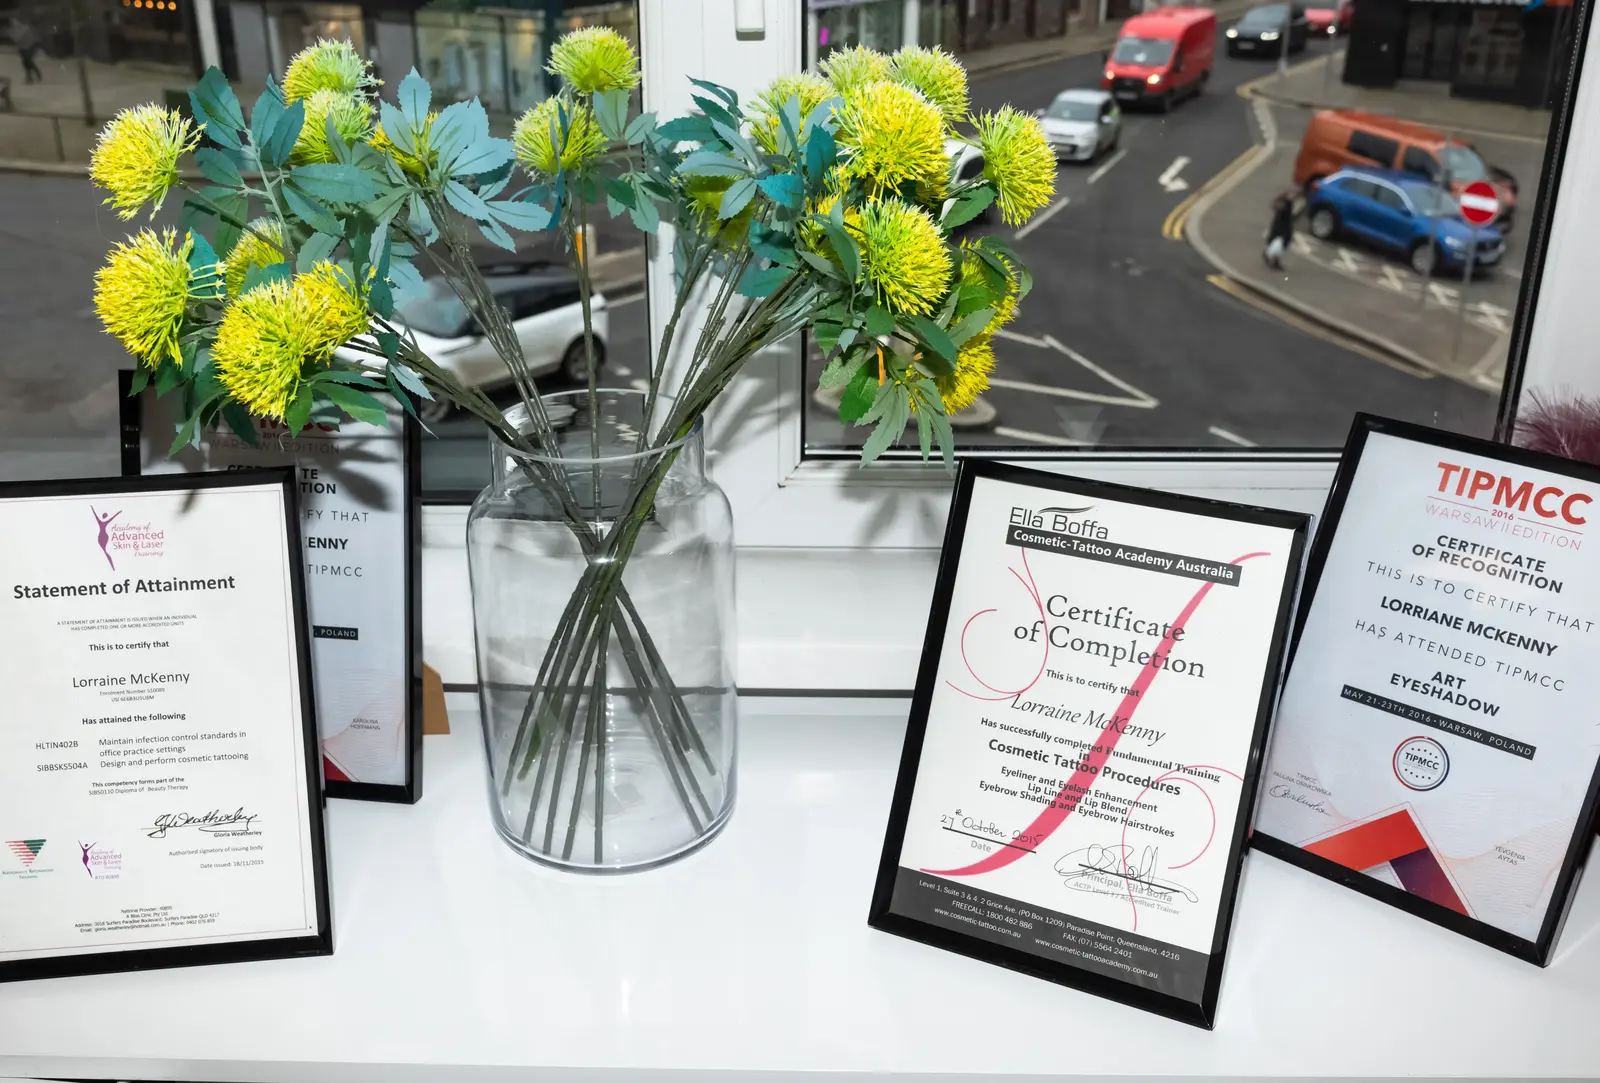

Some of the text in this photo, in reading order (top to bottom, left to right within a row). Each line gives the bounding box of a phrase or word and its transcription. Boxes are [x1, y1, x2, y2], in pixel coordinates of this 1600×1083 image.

[1437, 461, 1594, 526] TIPMCC
[331, 510, 369, 523] THAT
[1008, 506, 1109, 541] Ella Boffa
[1424, 502, 1582, 551] WARSAW EDITION
[1491, 508, 1514, 521] 2016
[111, 529, 164, 542] Advanced
[112, 540, 164, 550] Skin Laser
[305, 536, 349, 550] ENNY
[1013, 529, 1234, 580] Cosmetic-Tattoo Academy Australia
[1436, 534, 1547, 573] CERTIFICATE
[307, 564, 363, 578] TIPMCC
[1411, 543, 1564, 594] OF RECOGNITION
[13, 575, 236, 600] Statement of Attainment
[1367, 560, 1595, 633] THIS IS TO CERTIFY THAT
[1046, 594, 1186, 642] Certificate
[1380, 595, 1559, 657] LORRIANE MCKENNY
[88, 643, 106, 652] This
[106, 643, 114, 651] is
[125, 640, 152, 650] certify
[152, 640, 170, 648] that
[321, 628, 356, 638] POLAND
[1014, 620, 1205, 679] of Completion
[1354, 619, 1565, 692] HAS ATTENDED TIPMCC
[72, 672, 190, 688] Lorraine McKenny
[1046, 668, 1140, 697] This is to certify that
[1430, 671, 1467, 690] ART
[1389, 672, 1501, 717] EYESHADOW
[81, 712, 186, 725] Has attained the following
[1010, 691, 1167, 747] Lorraine McKenny
[1343, 688, 1532, 756] MAY 21-23TH 2016 WARSAW, POLAND
[35, 740, 79, 750] HLTIN402B
[98, 738, 134, 746] Maintain
[135, 735, 170, 744] infection
[171, 733, 199, 742] control
[200, 731, 238, 740] standards
[99, 746, 186, 757] office practice settings
[980, 717, 1221, 783] Has successfully completed Fundamental Training
[100, 753, 249, 769] Design and perform cosmetic tattooing
[988, 739, 1181, 796] Cosmetic Tattoo Procedures
[1078, 748, 1091, 762] in
[1405, 751, 1440, 771] TIPMCC
[104, 780, 138, 788] competency
[1000, 765, 1158, 813] Eyeliner and Eyelash Enhancement
[979, 780, 1175, 838] Eyebrow Shading and Eyebrow Hairstrokes
[1027, 782, 1128, 816] Lip Line and Lip Blend
[231, 829, 262, 837] Weatherley
[962, 816, 1007, 838] October
[1012, 829, 1044, 847] 2015
[970, 839, 992, 853] Date
[1127, 882, 1144, 895] Ella
[1147, 887, 1173, 903] Boffa
[919, 879, 936, 890] Level
[943, 886, 960, 897] Suite
[986, 899, 1003, 910] Grice
[1018, 909, 1031, 918] (PO
[1030, 912, 1044, 922] Box
[1045, 916, 1066, 929] 1209)
[1066, 922, 1096, 937] Paradise
[1160, 949, 1181, 961] 4216
[951, 899, 1033, 930] FREECALL: 1800 482 886
[1062, 932, 1133, 959] FAX: (07) 5564 2401
